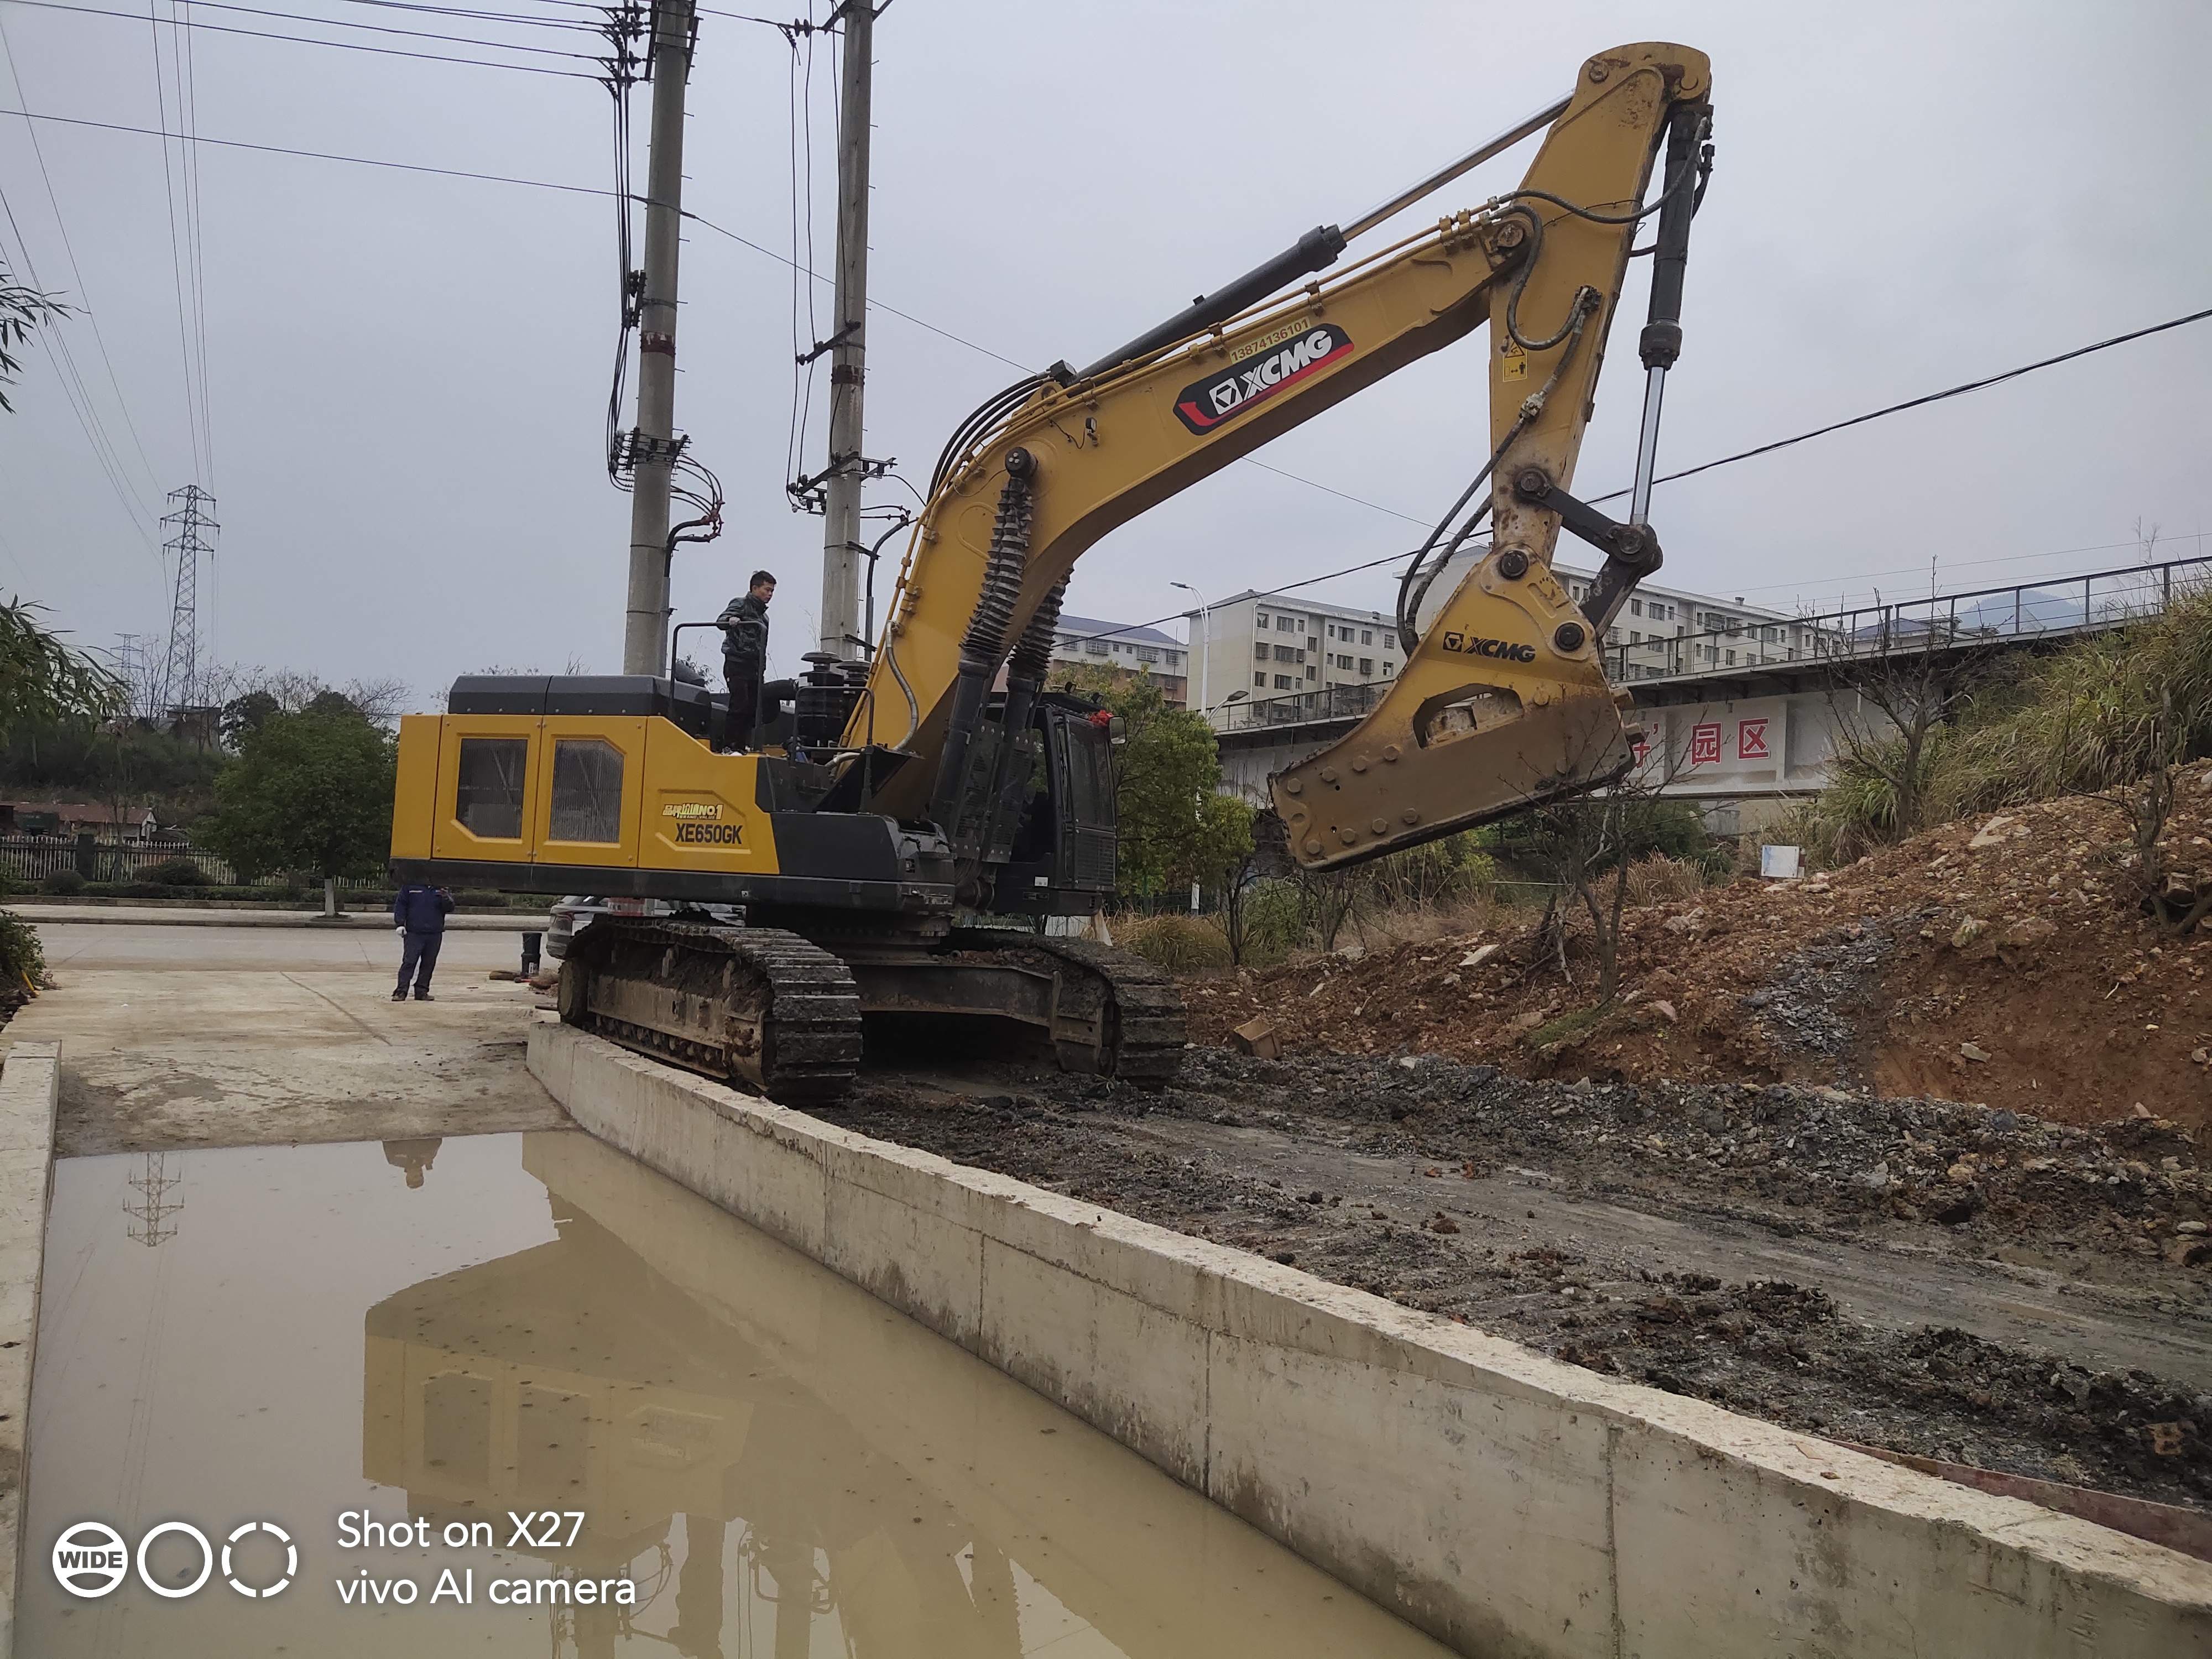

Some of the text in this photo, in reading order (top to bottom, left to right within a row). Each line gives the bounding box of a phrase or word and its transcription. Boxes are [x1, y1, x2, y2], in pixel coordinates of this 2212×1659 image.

[1232, 319, 1310, 362] 13874136101
[1240, 330, 1332, 400] XCMG
[1464, 637, 1536, 662] XCMG
[675, 823, 743, 844] XE650GK
